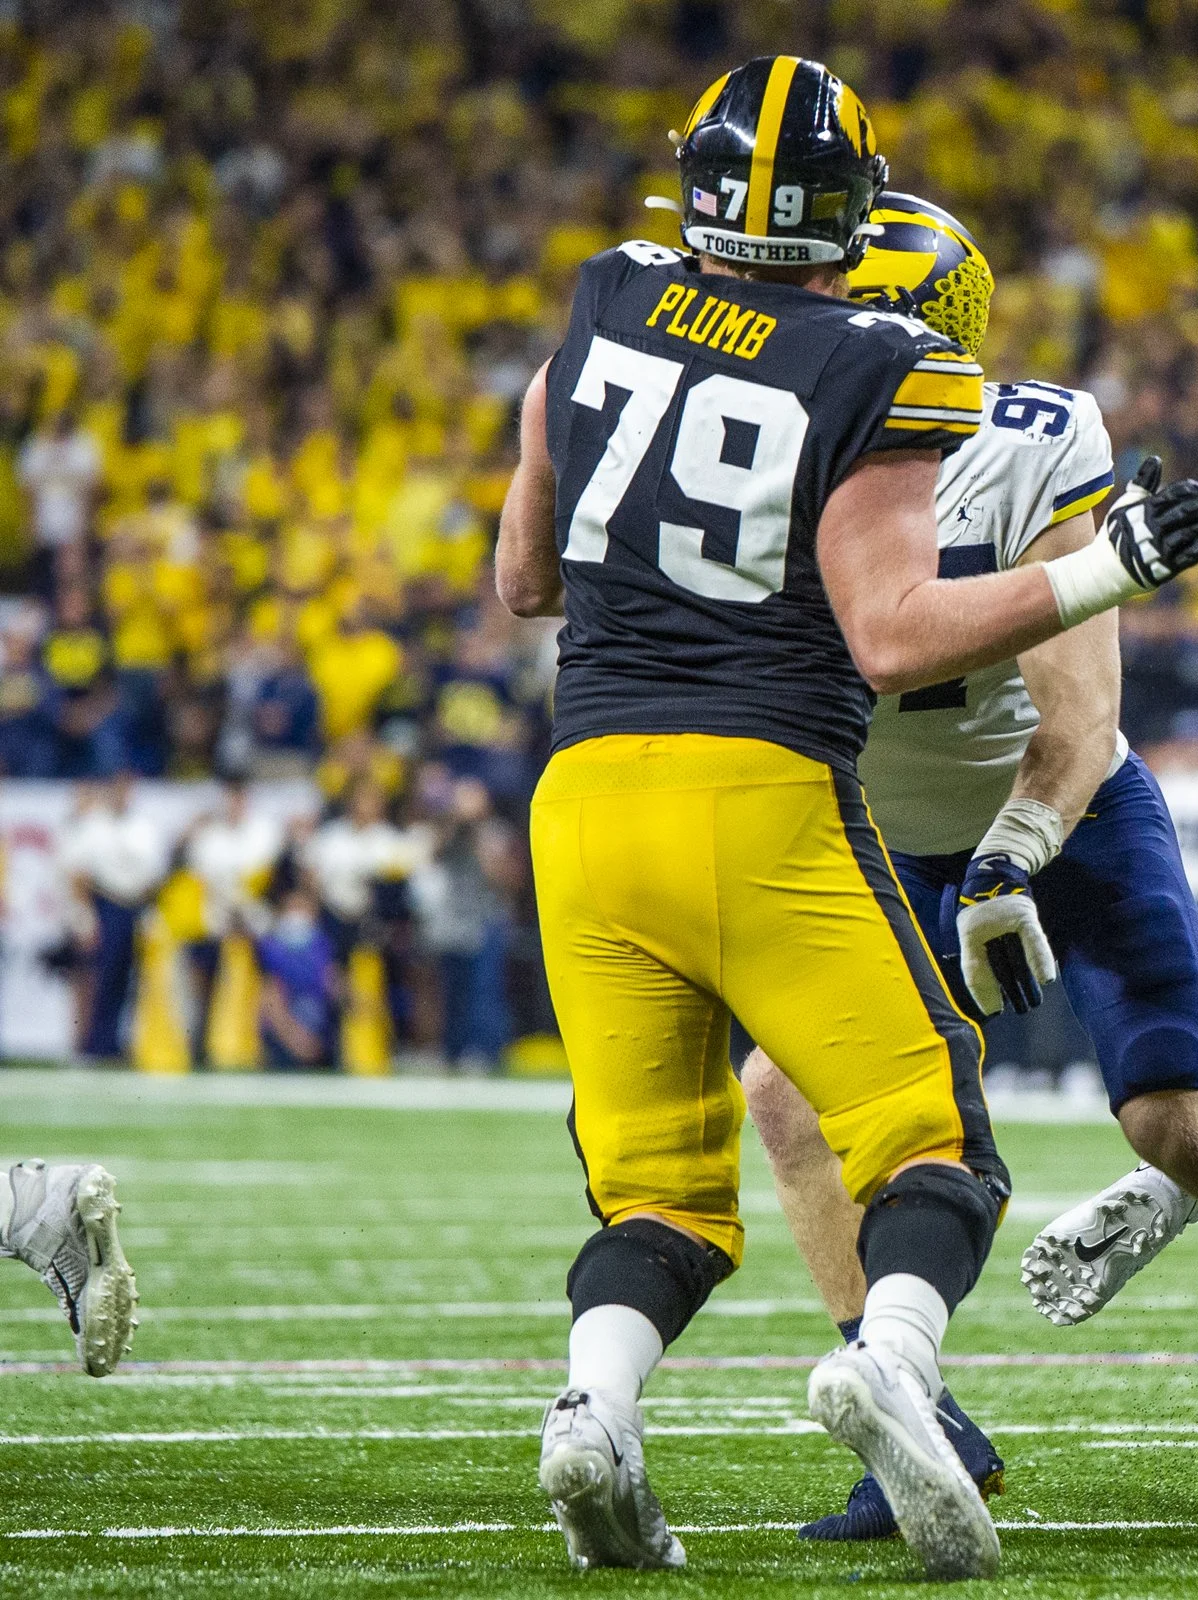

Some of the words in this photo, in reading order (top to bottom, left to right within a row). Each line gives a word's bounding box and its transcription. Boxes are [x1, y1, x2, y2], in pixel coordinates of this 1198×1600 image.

[720, 177, 804, 227] 79
[703, 234, 812, 262] TOGETHER
[646, 283, 777, 360] PLUMB
[561, 335, 810, 604] 79
